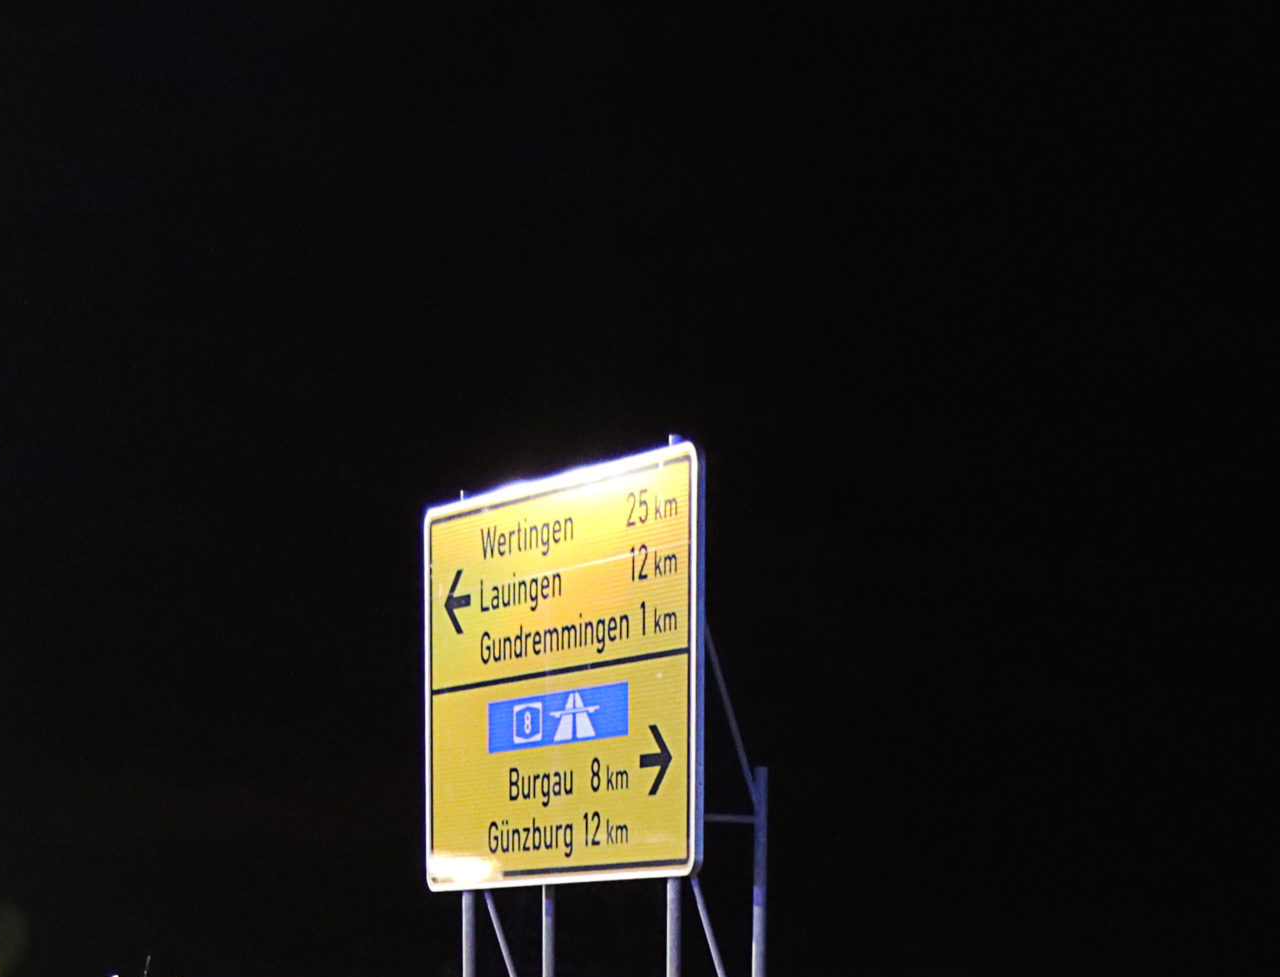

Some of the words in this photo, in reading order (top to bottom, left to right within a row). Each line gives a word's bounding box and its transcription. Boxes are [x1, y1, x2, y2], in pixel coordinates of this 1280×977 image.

[480, 516, 574, 560] Wertingen
[626, 489, 649, 528] 25
[654, 494, 678, 521] km
[480, 572, 563, 613] Lauingen
[629, 544, 649, 582] 12
[654, 551, 678, 578] km
[480, 613, 630, 665] Gundremmingen
[640, 601, 647, 636] 1
[654, 608, 678, 634] km
[523, 710, 532, 735] 8
[509, 767, 574, 807] Burgau
[591, 757, 601, 792] 8
[606, 765, 629, 790] km
[488, 817, 574, 857] Günzburg
[583, 811, 601, 847] 12
[606, 824, 629, 846] km
